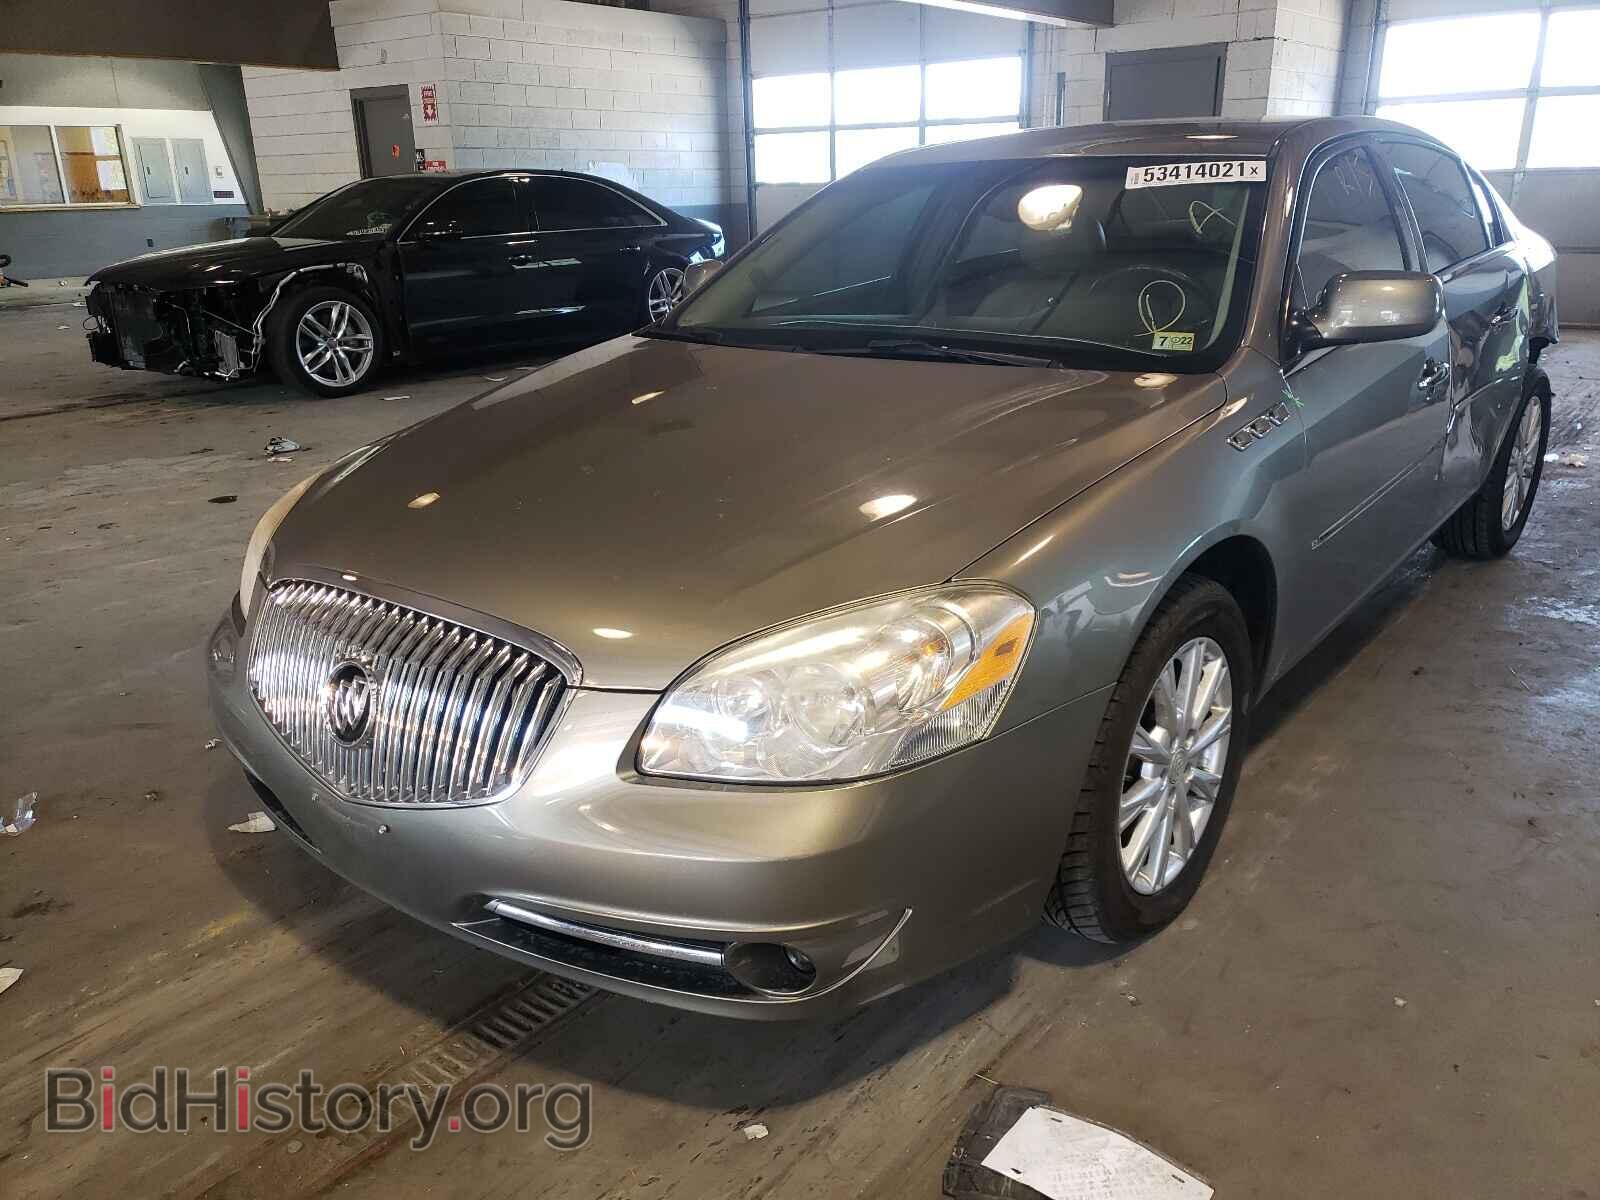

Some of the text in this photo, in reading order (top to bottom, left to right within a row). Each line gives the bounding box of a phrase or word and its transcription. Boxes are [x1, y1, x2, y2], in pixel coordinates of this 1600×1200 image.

[1143, 162, 1245, 181] 53414021
[1159, 336, 1193, 346] 7 22
